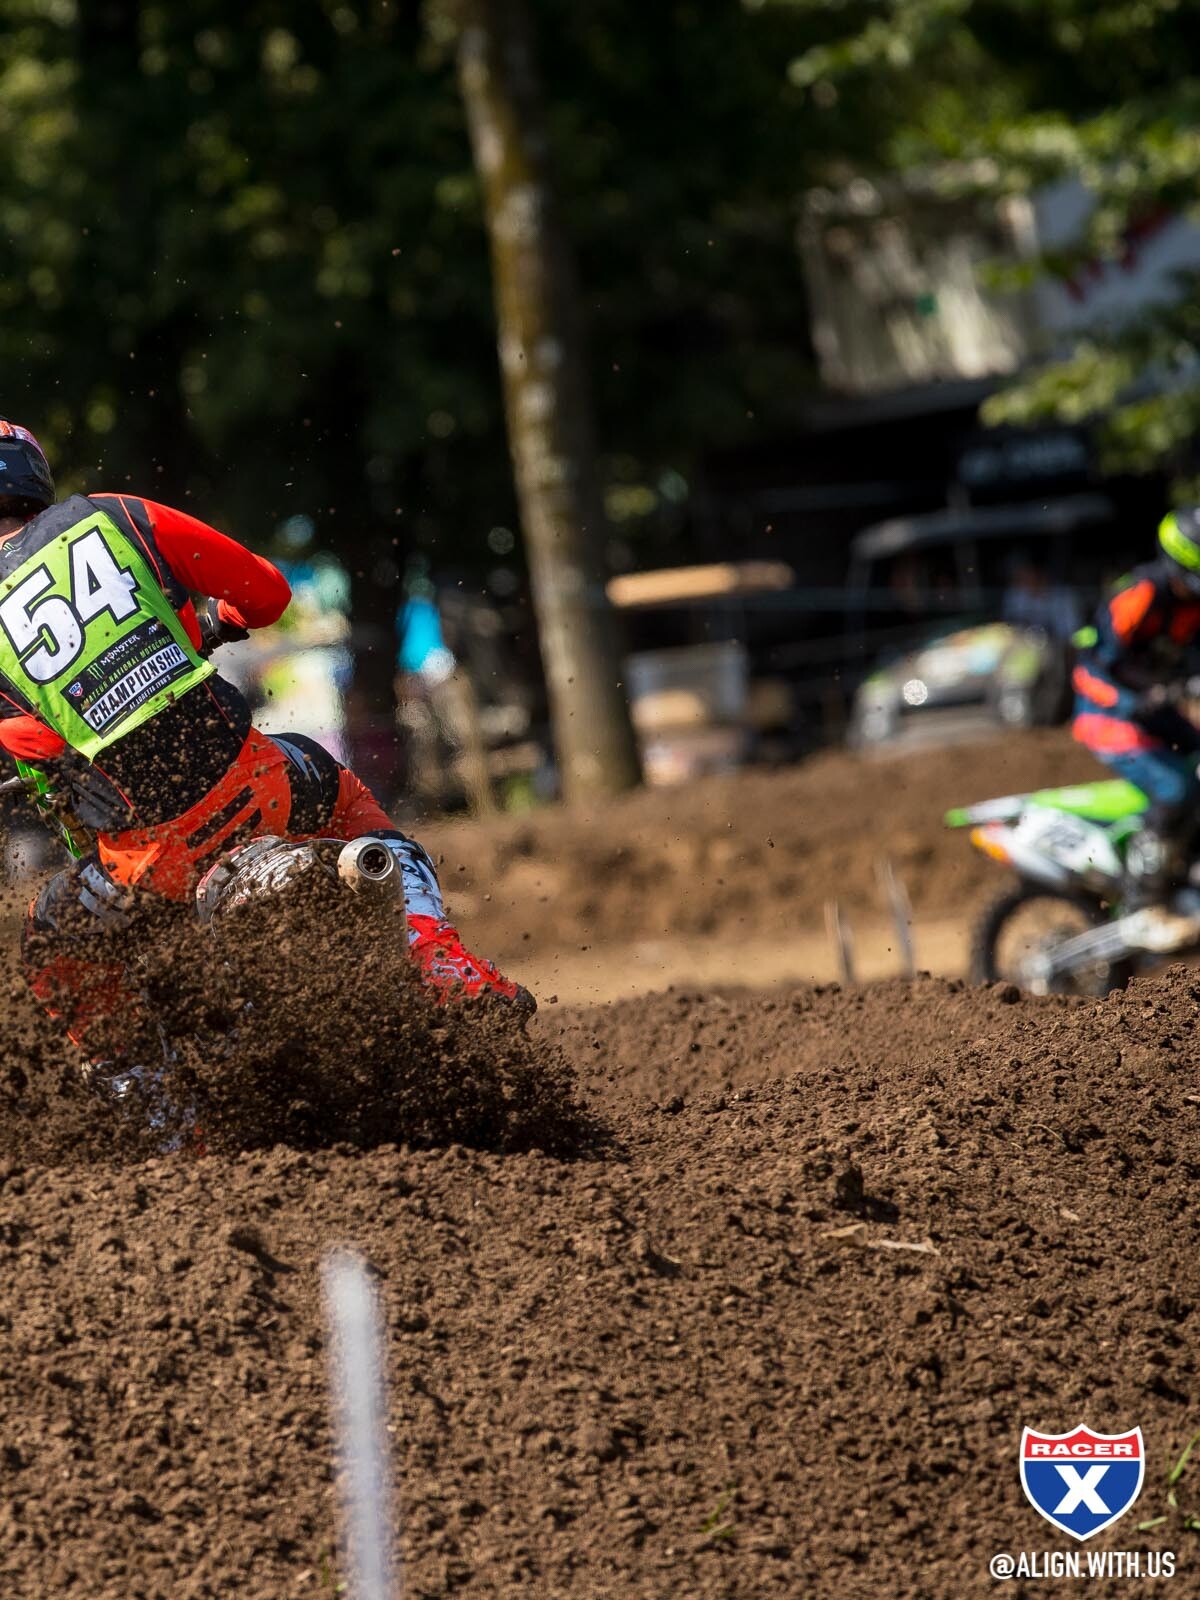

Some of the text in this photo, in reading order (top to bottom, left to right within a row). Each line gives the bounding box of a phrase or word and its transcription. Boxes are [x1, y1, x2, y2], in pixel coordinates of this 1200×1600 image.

[100, 634, 140, 666] MONSTER
[109, 656, 140, 683] NATIONAL
[90, 645, 183, 727] CHAMPIONSHIP
[130, 701, 136, 710] AT
[136, 685, 156, 705] LORETTA
